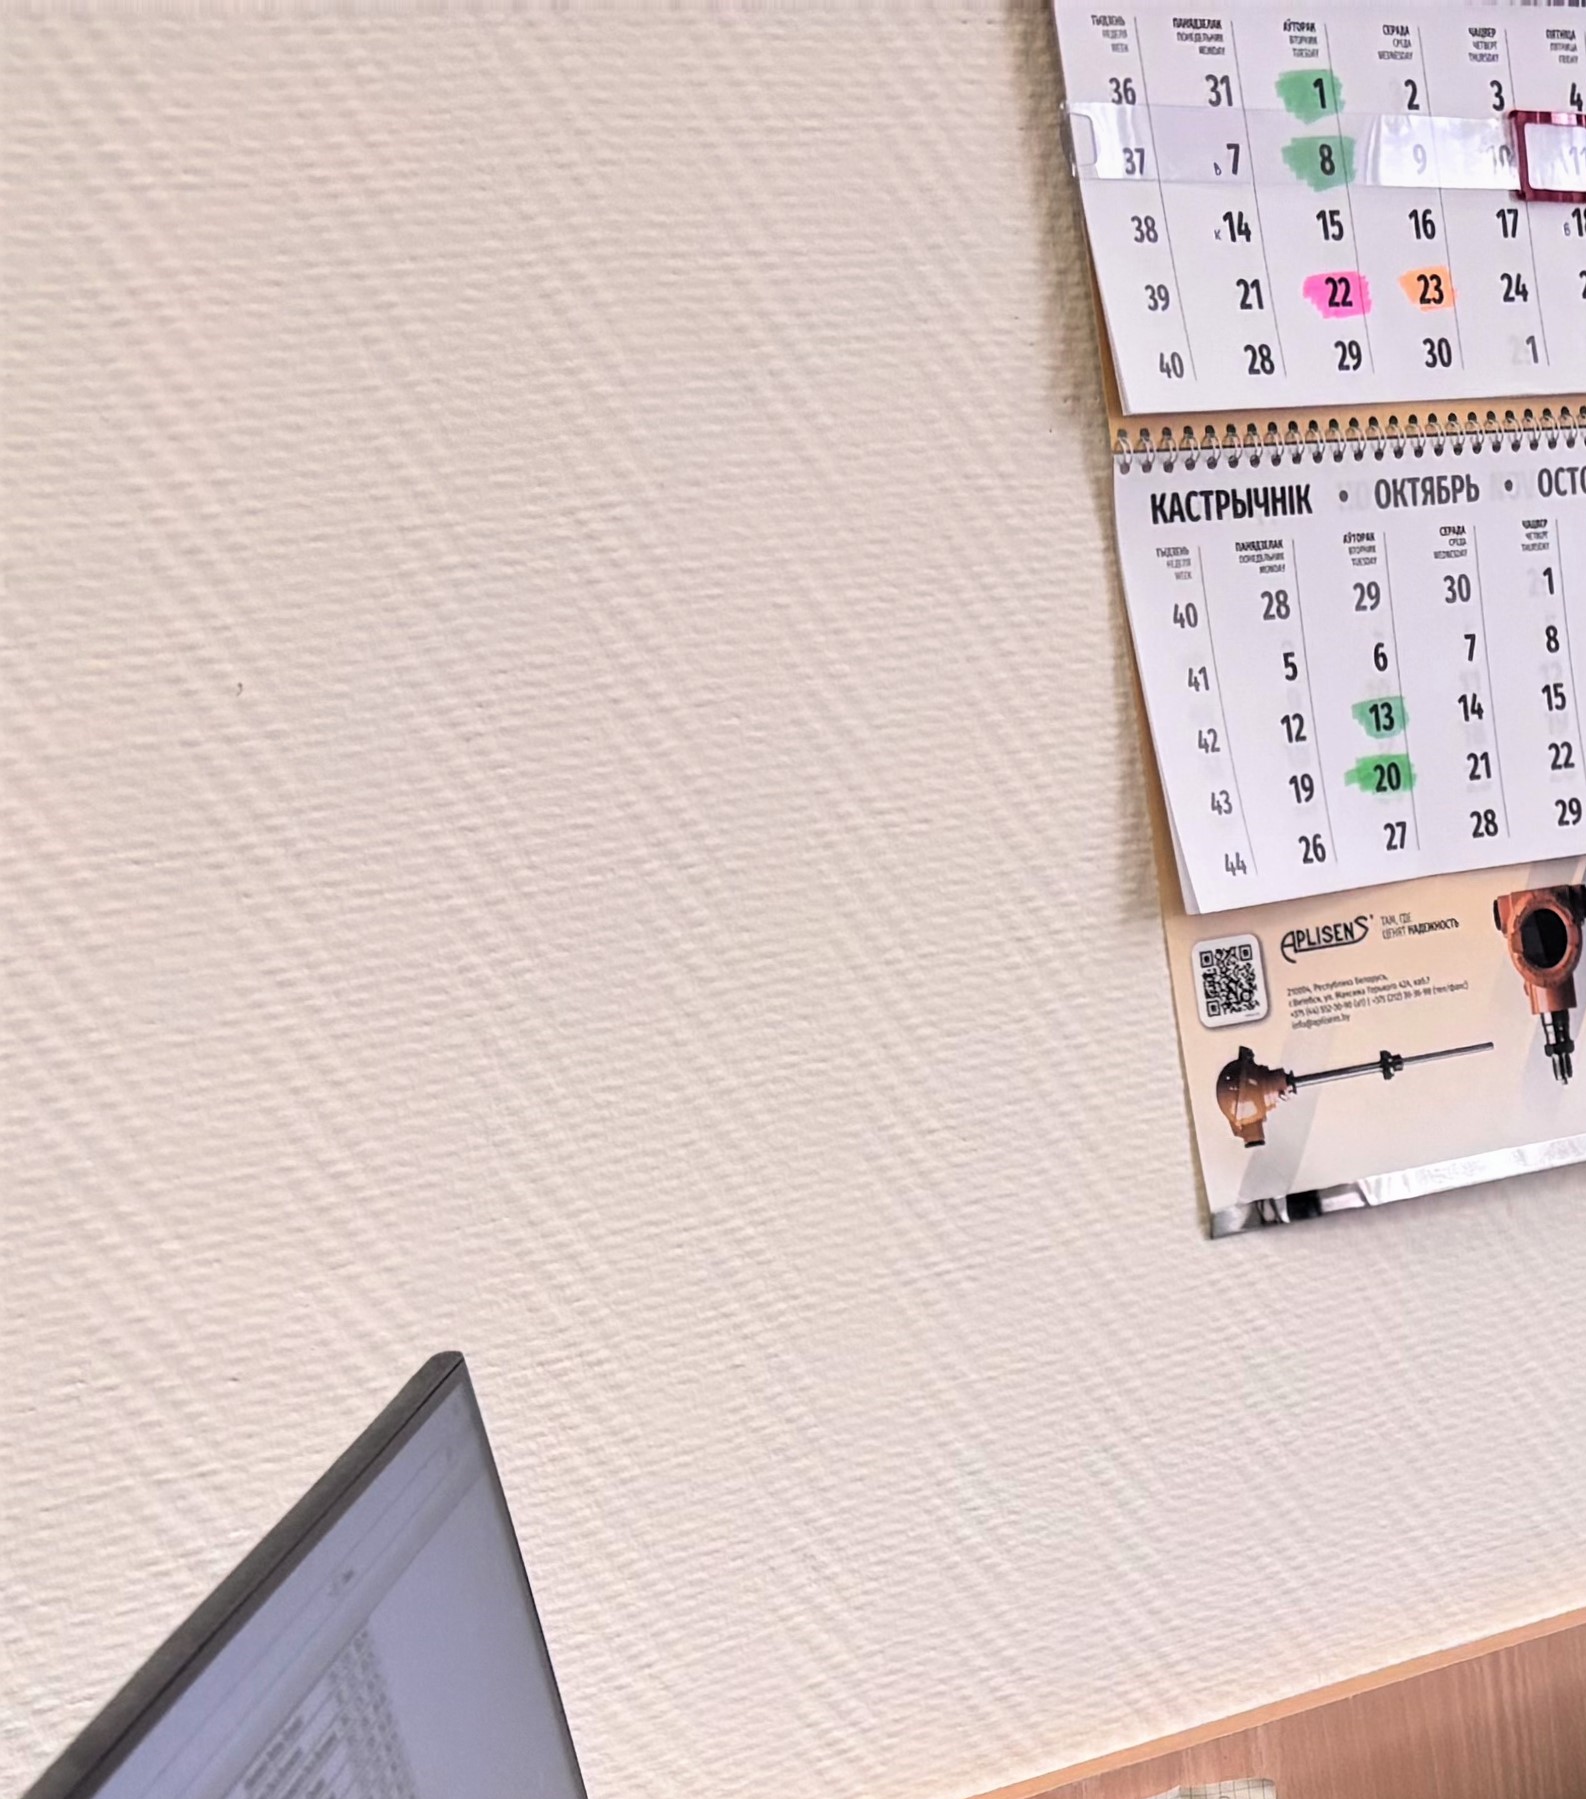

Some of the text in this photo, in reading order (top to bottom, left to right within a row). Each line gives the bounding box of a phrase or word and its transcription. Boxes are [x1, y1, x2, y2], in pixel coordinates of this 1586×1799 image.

[1109, 77, 1136, 105] 36
[1205, 74, 1233, 107] 31
[1313, 78, 1327, 109] 1
[1405, 79, 1420, 111] 2
[1490, 80, 1505, 111] 3
[1569, 82, 1583, 112] 4
[1123, 148, 1145, 175] 37
[1226, 143, 1240, 175] 7
[1318, 143, 1336, 176] 8
[1412, 144, 1428, 174] 9
[1131, 216, 1158, 243] 38
[1223, 211, 1251, 242] 14
[1316, 209, 1344, 241] 15
[1409, 209, 1436, 240] 16
[1496, 209, 1519, 238] 17
[1145, 284, 1170, 312] 39
[1237, 279, 1264, 310] 21
[1325, 277, 1353, 308] 22
[1417, 274, 1444, 305] 23
[1500, 273, 1529, 303] 24
[1159, 352, 1184, 379] 40
[1244, 344, 1275, 375] 28
[1334, 340, 1362, 371] 29
[1422, 338, 1453, 368] 30
[1526, 336, 1539, 364] 1
[1150, 484, 1313, 525] КАСТРЫЧНІК
[1374, 473, 1480, 510] ОКТЯБРЬ
[1172, 602, 1199, 629] 40
[1260, 589, 1291, 621] 28
[1353, 581, 1381, 612] 29
[1443, 573, 1471, 604] 30
[1542, 567, 1555, 595] 1
[1188, 666, 1209, 692] 41
[1283, 652, 1298, 681] 5
[1373, 642, 1388, 671] 6
[1463, 633, 1476, 662] 7
[1545, 625, 1560, 653] 8
[1198, 729, 1220, 753] 42
[1280, 713, 1307, 743] 12
[1369, 702, 1394, 732] 13
[1458, 693, 1484, 722] 14
[1541, 683, 1566, 711] 15
[1211, 790, 1232, 815] 43
[1289, 774, 1314, 804] 19
[1374, 762, 1400, 792] 20
[1467, 752, 1491, 781] 21
[1549, 741, 1575, 770] 22
[1224, 852, 1247, 876] 44
[1299, 834, 1326, 864] 26
[1384, 821, 1407, 851] 27
[1470, 809, 1498, 838] 28
[1555, 797, 1582, 826] 29
[1281, 913, 1370, 964] APLISENS
